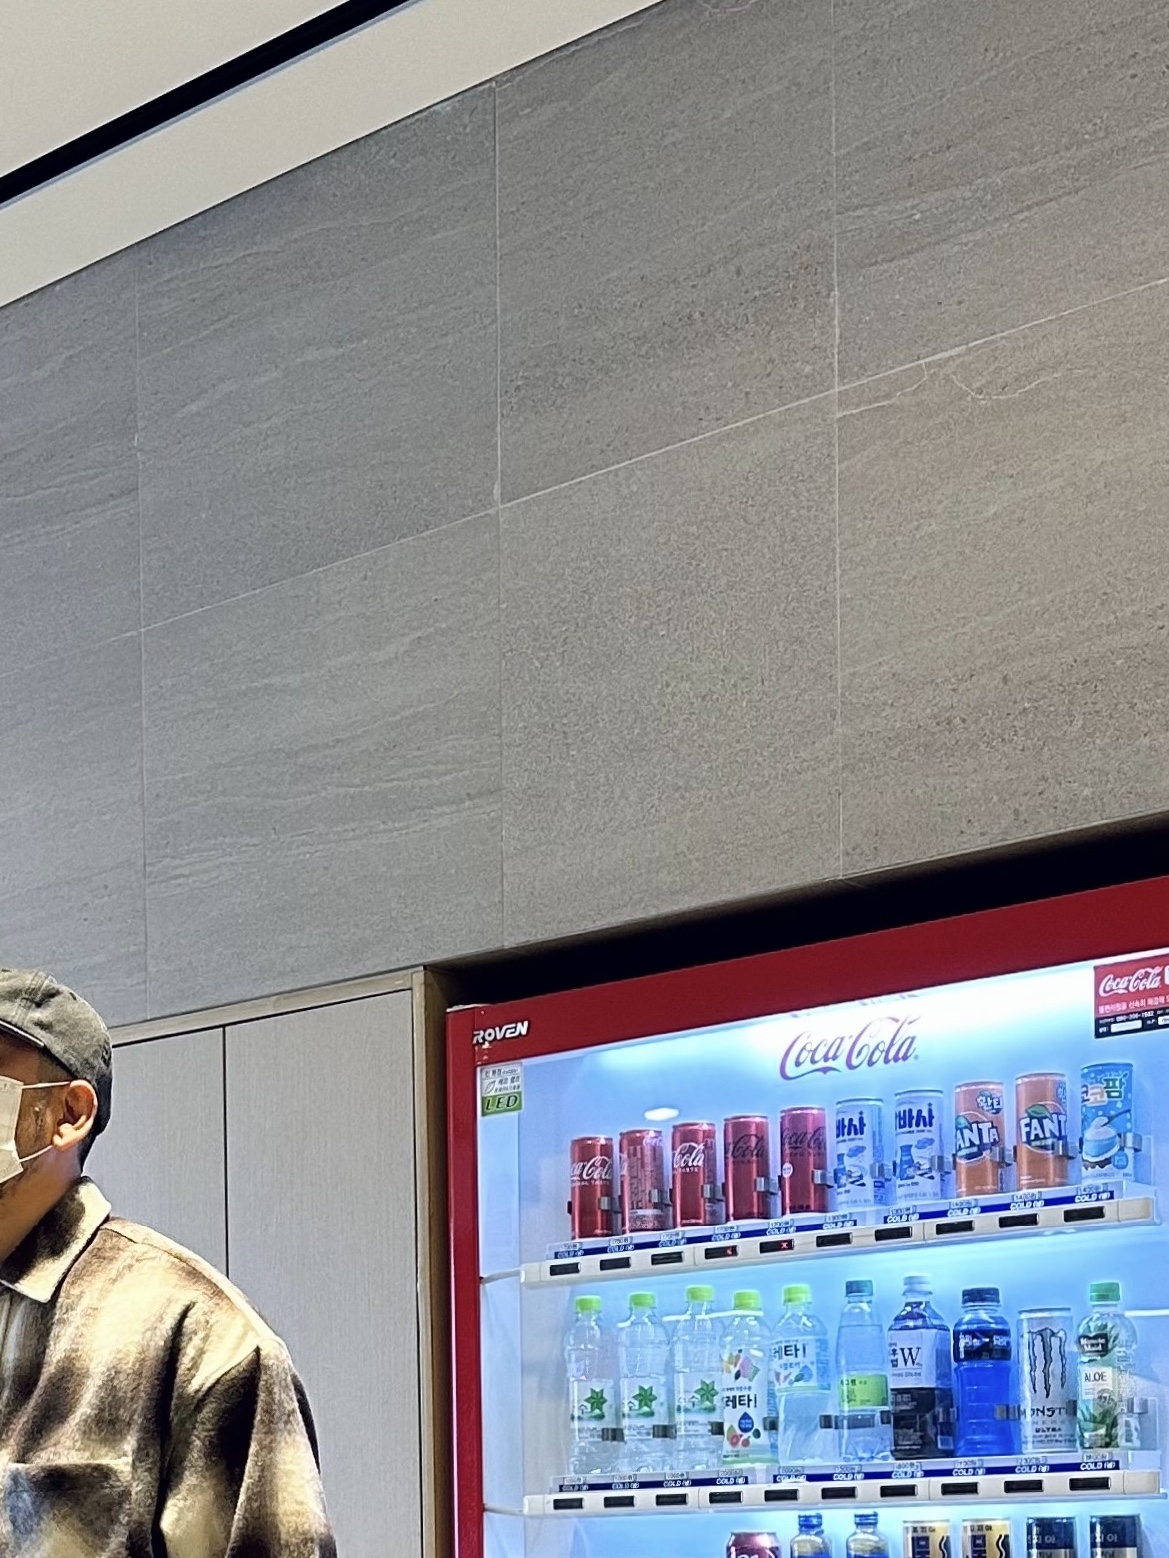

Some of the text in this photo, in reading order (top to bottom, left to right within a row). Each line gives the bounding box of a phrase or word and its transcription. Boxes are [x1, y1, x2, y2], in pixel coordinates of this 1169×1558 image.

[1099, 966, 1163, 997] Coca-Cola
[473, 1021, 529, 1044] ROVEN
[779, 1014, 921, 1081] Coca-Cola
[485, 1095, 518, 1111] LED
[895, 1106, 935, 1130] 바사
[1084, 1371, 1107, 1382] ALOE
[722, 1394, 757, 1410] 레타!
